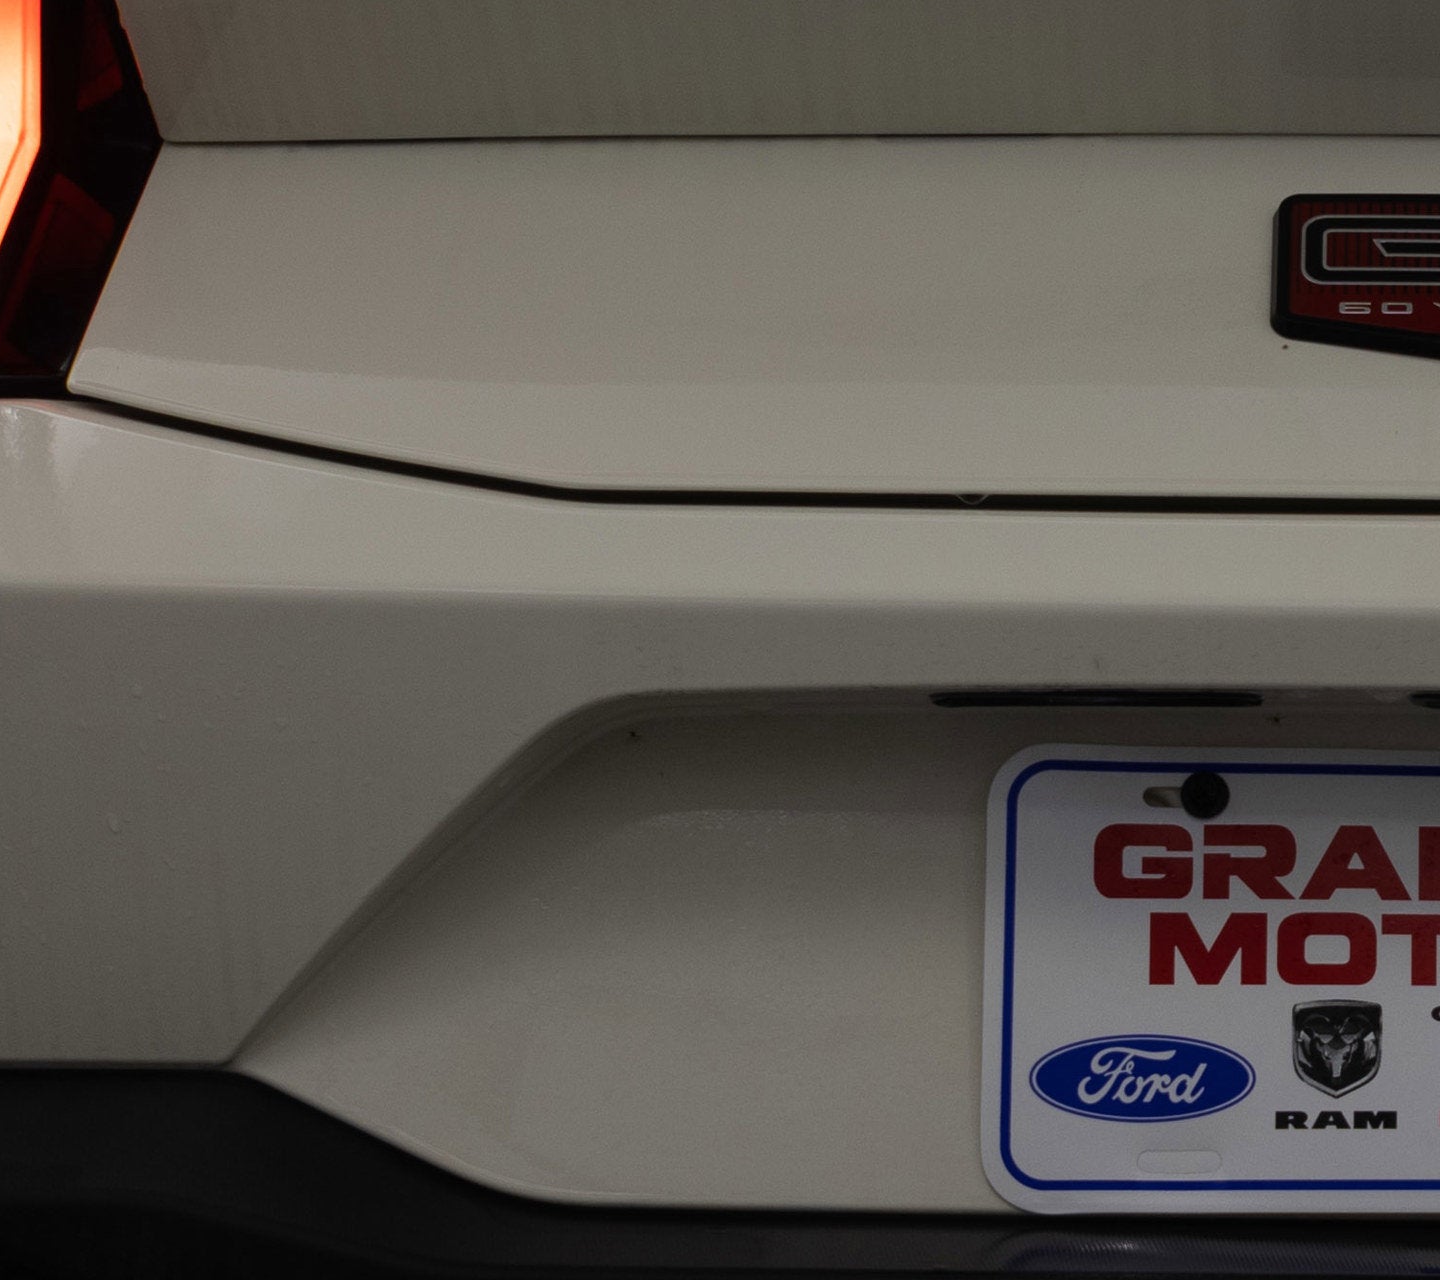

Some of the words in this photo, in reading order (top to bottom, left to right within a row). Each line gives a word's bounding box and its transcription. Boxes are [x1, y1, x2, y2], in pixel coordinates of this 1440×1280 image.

[1338, 301, 1413, 316] 60
[1078, 1045, 1208, 1106] Ford
[1274, 1110, 1398, 1130] RAM
